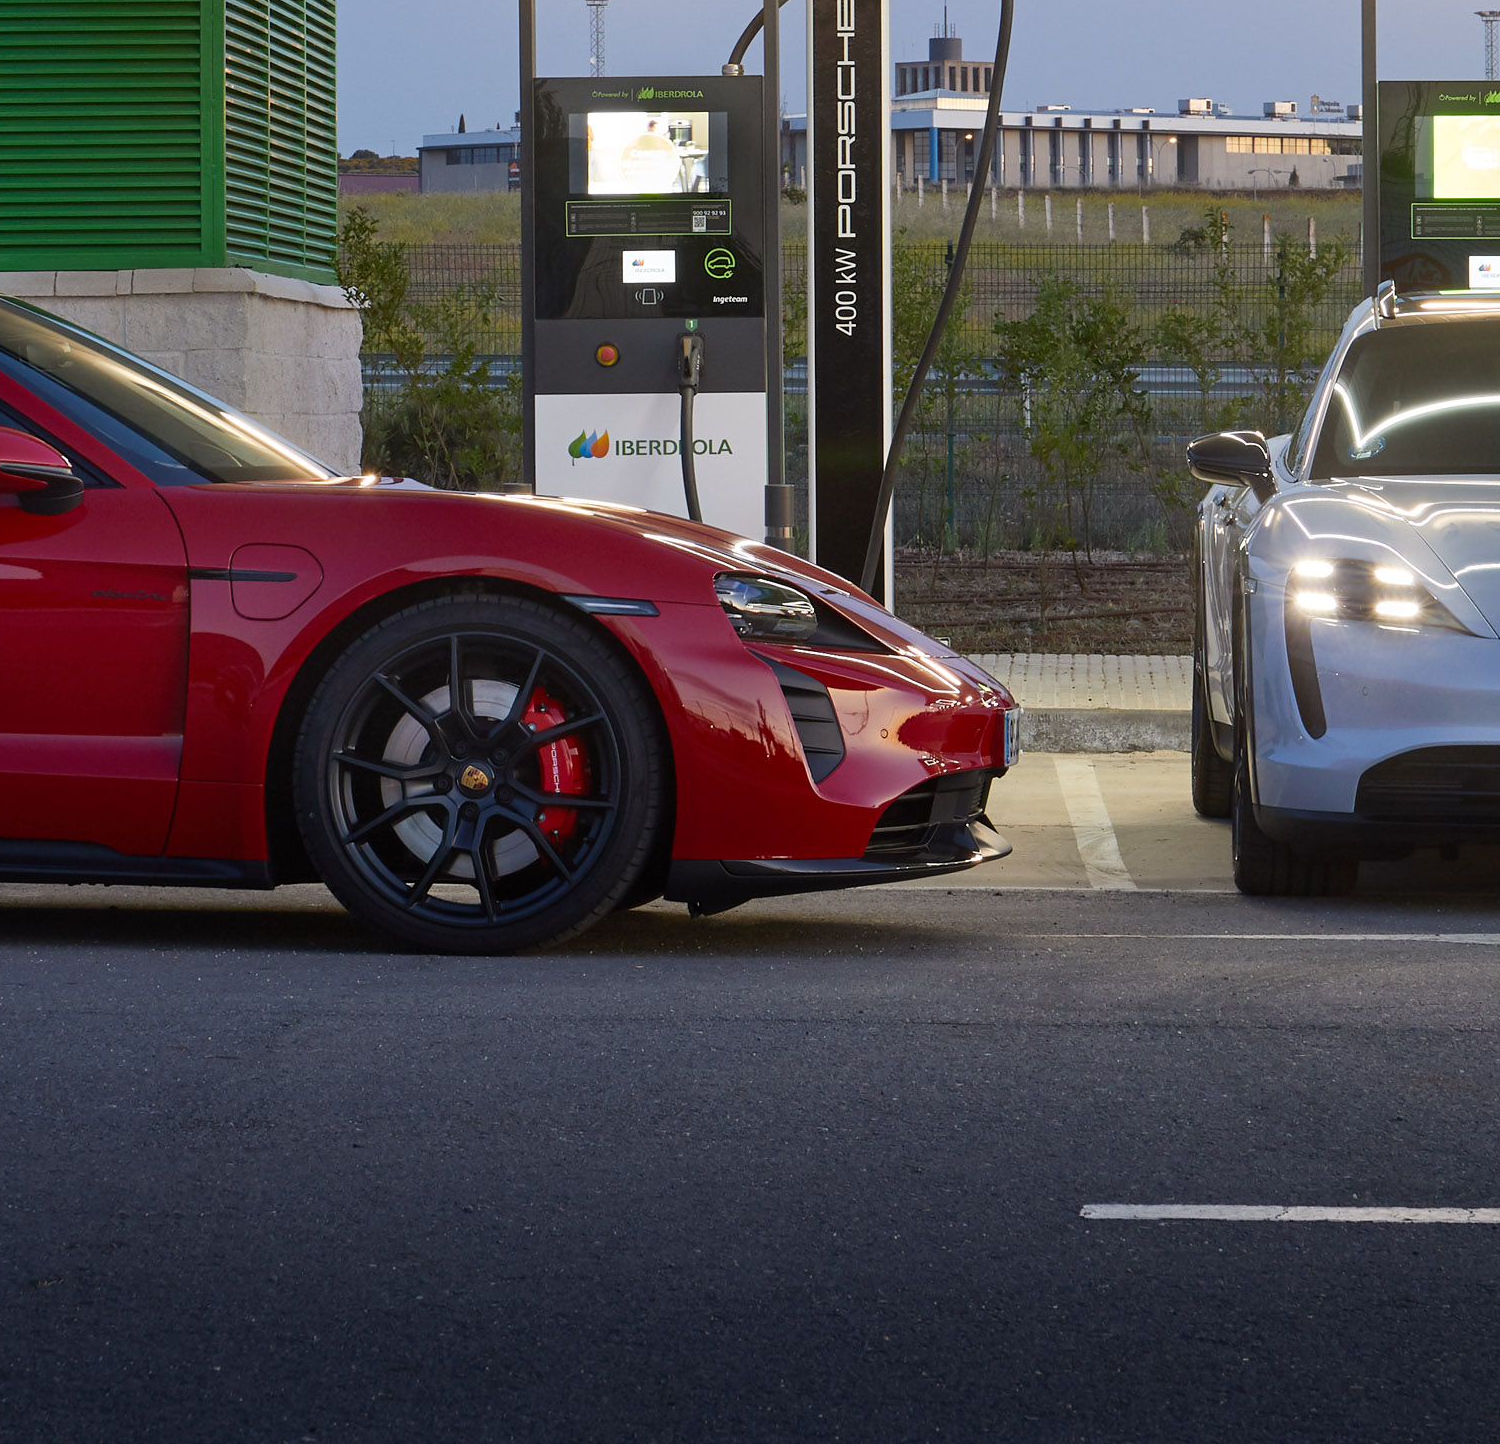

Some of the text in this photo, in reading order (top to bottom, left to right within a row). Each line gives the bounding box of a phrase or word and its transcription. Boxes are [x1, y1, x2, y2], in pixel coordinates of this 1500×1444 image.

[598, 90, 704, 100] Powered by IBERDROLA
[1445, 94, 1469, 102] Powered
[1469, 94, 1477, 103] by
[835, 247, 858, 285] kW
[712, 295, 748, 305] Ingeteam
[835, 289, 858, 337] 400
[689, 320, 694, 328] 1
[615, 439, 733, 456] IBERDOLA
